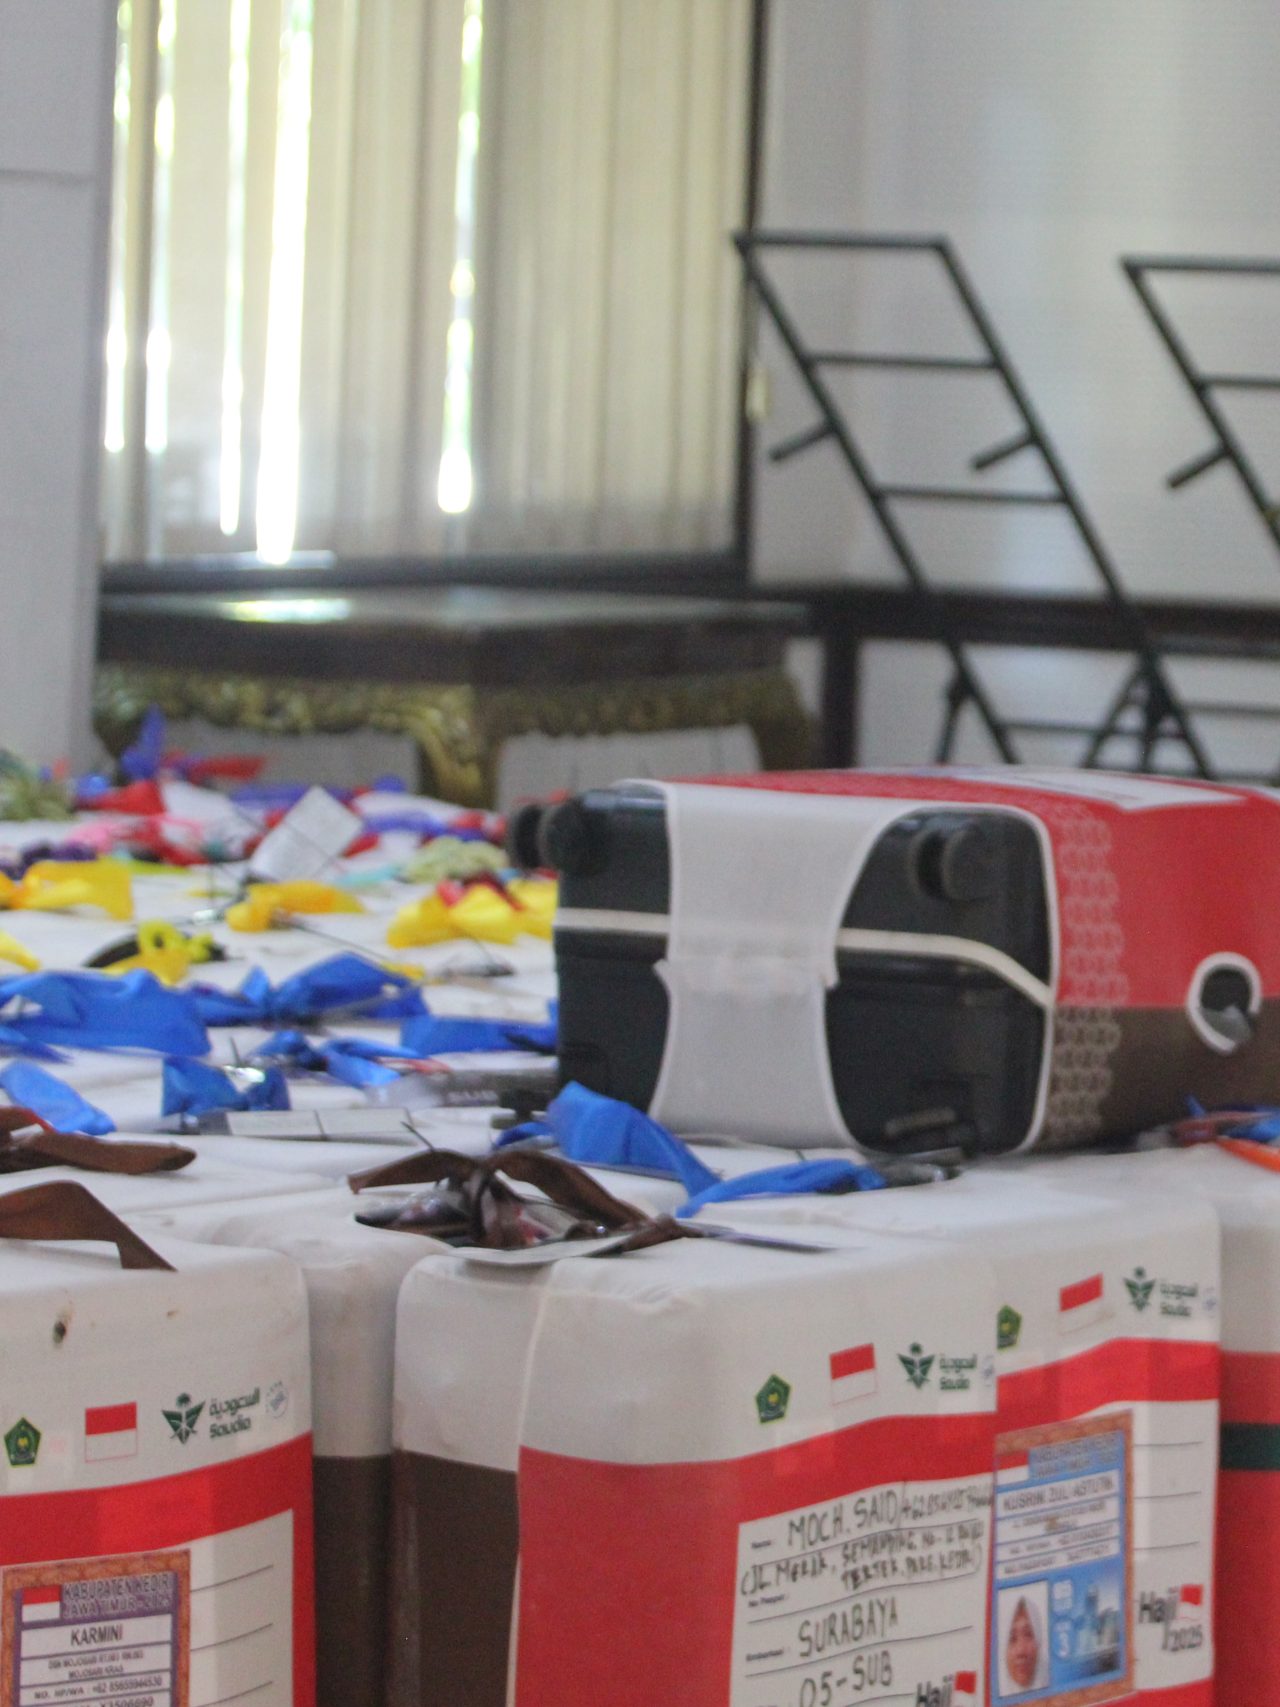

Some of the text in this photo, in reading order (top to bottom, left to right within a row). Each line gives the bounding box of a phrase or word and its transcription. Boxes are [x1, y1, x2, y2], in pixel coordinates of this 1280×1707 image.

[853, 1490, 900, 1528] SAID
[64, 1578, 133, 1600] KABUPATEN
[71, 1623, 123, 1646] KARMINI
[798, 1597, 898, 1658] SURABAYA
